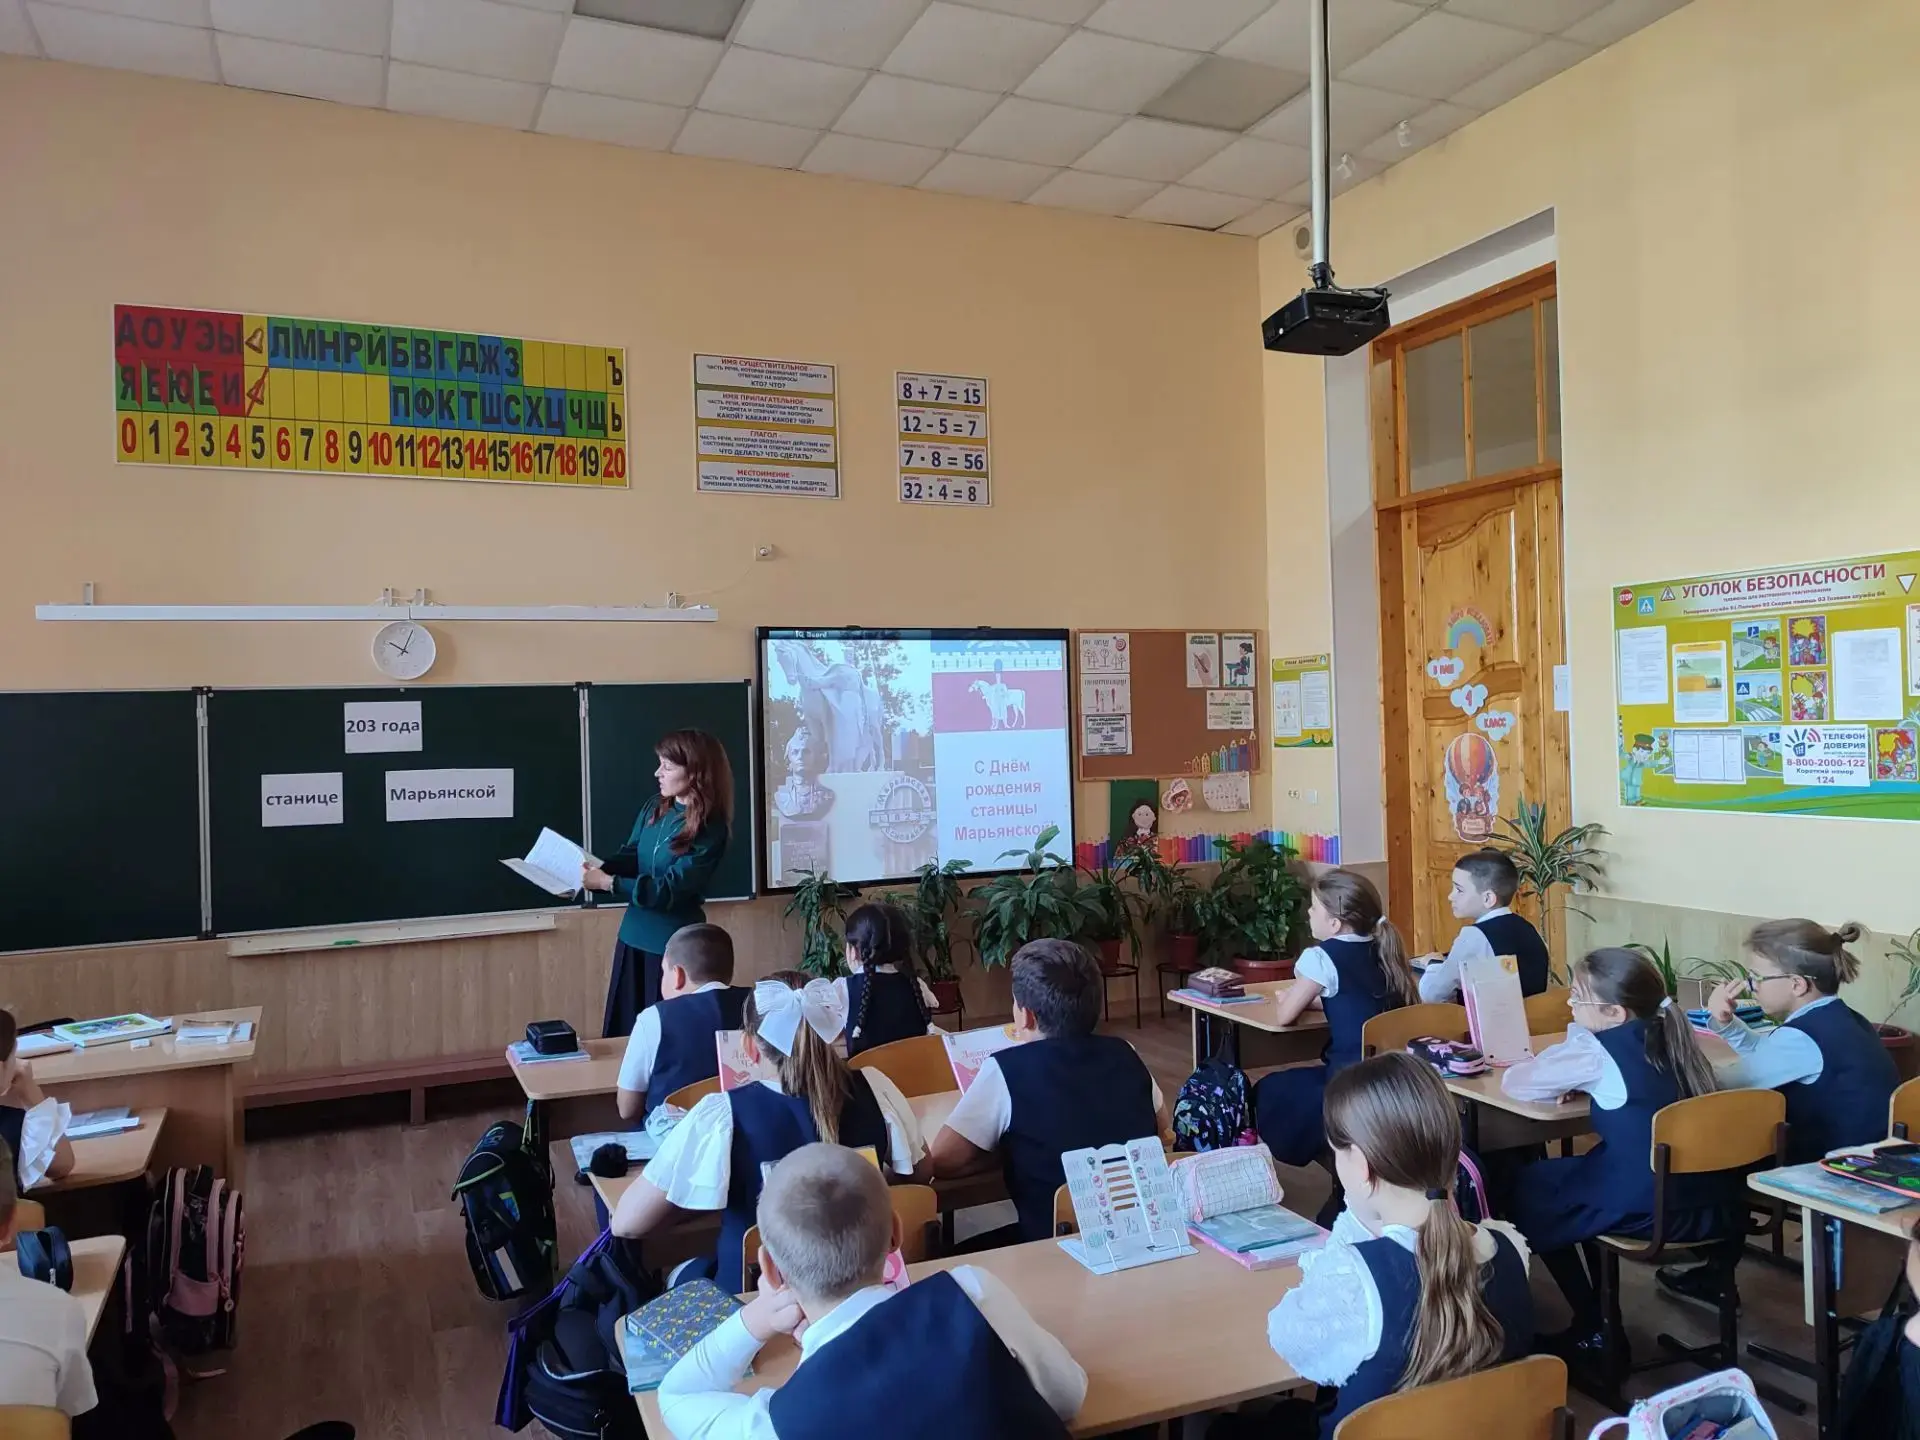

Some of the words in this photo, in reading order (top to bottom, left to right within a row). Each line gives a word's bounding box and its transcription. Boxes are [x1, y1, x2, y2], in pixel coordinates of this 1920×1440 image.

[903, 382, 913, 399] 8
[933, 385, 943, 401] 7
[963, 388, 981, 405] 15
[903, 415, 922, 432] 12
[939, 418, 948, 434] 5
[968, 420, 977, 436] 7
[121, 417, 137, 454] 0
[149, 419, 160, 454] 1
[174, 421, 190, 456] 2
[201, 422, 215, 457] 3
[226, 424, 241, 459] 4
[251, 425, 265, 459] 5
[276, 427, 291, 461] 6
[301, 428, 314, 461] 7
[325, 429, 339, 464] 8
[348, 431, 362, 464] 9
[368, 432, 393, 466] 10
[395, 434, 415, 467] 11
[417, 435, 441, 469] 12
[442, 437, 464, 470] 13
[465, 438, 488, 471] 14
[489, 440, 510, 473] 15
[511, 441, 533, 474] 16
[534, 443, 554, 474] 17
[556, 444, 577, 476] 18
[579, 446, 600, 477] 19
[603, 448, 626, 479] 20
[904, 449, 914, 466] 7
[931, 451, 942, 468] 8
[964, 453, 984, 470] 56
[903, 482, 923, 499] 32
[938, 484, 948, 500] 4
[968, 486, 977, 502] 8
[1682, 580, 1742, 599] УГОЛОК
[1747, 563, 1886, 592] БЕЗОПАСНОСТИ
[346, 719, 376, 733] 203
[381, 719, 421, 735] года
[974, 759, 985, 774] С
[989, 758, 1030, 776] Днём
[1786, 758, 1866, 768] 8-800-2000-122
[1816, 776, 1835, 784] 124
[265, 792, 339, 807] станице
[390, 785, 496, 804] Марьянской
[965, 782, 1042, 800] рождения
[971, 803, 1038, 817] станицы
